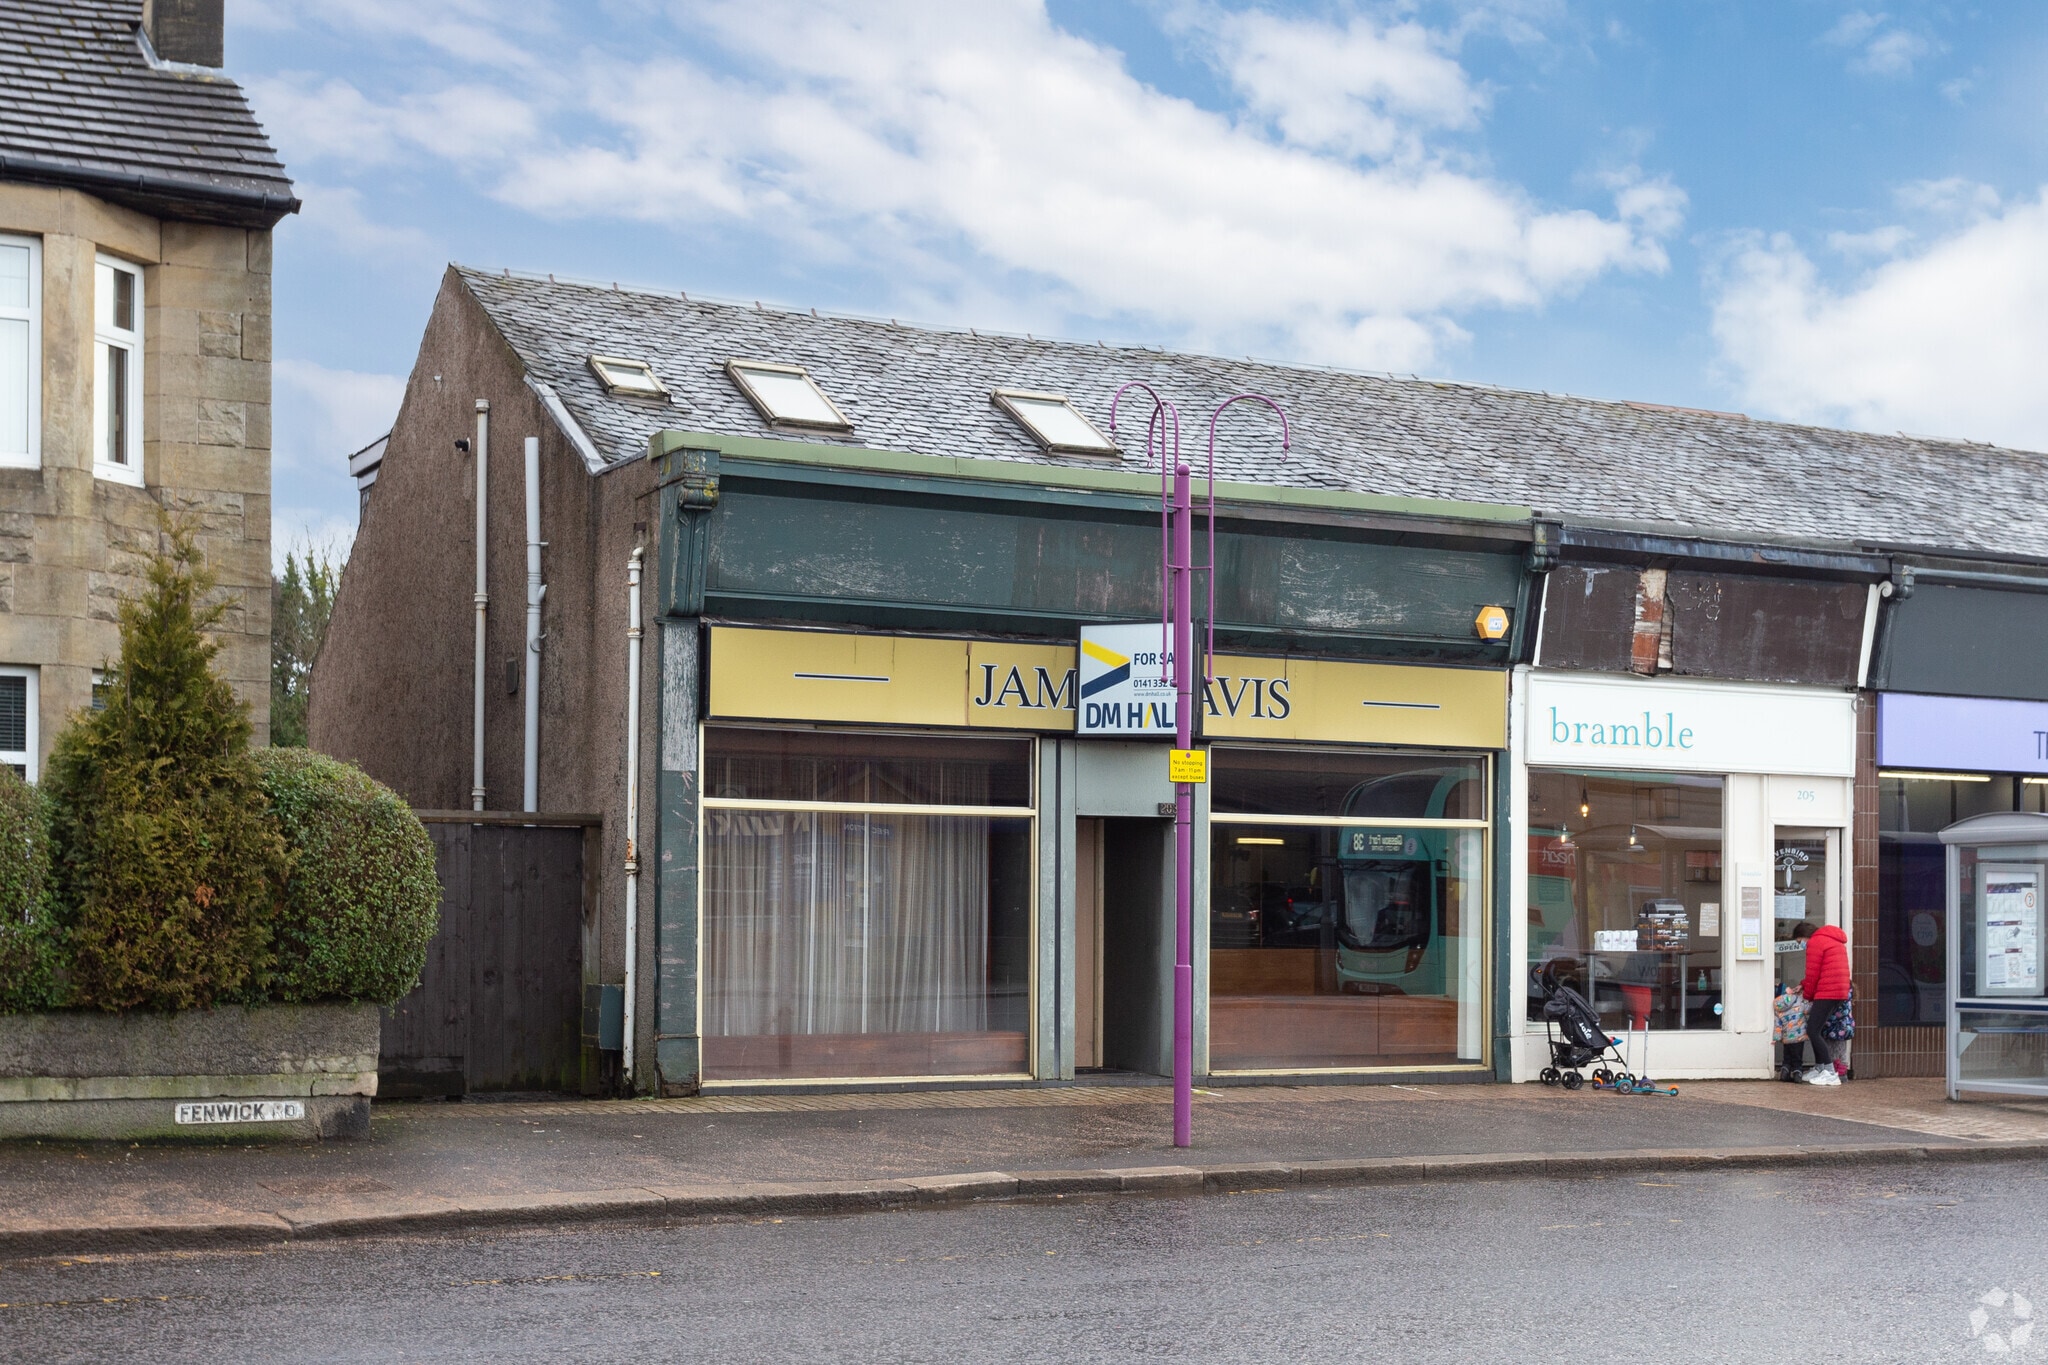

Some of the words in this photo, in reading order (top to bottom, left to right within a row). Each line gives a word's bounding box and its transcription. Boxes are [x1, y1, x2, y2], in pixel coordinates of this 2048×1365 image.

[1134, 652, 1157, 666] FOR
[1133, 679, 1152, 688] 0141
[1085, 702, 1121, 729] DM
[1127, 702, 1178, 729] HAL
[1550, 706, 1695, 749] bramble
[2033, 730, 2048, 760] T
[1796, 790, 1816, 802] 205
[1778, 943, 1800, 952] OPEN
[179, 1103, 265, 1123] FENWICK
